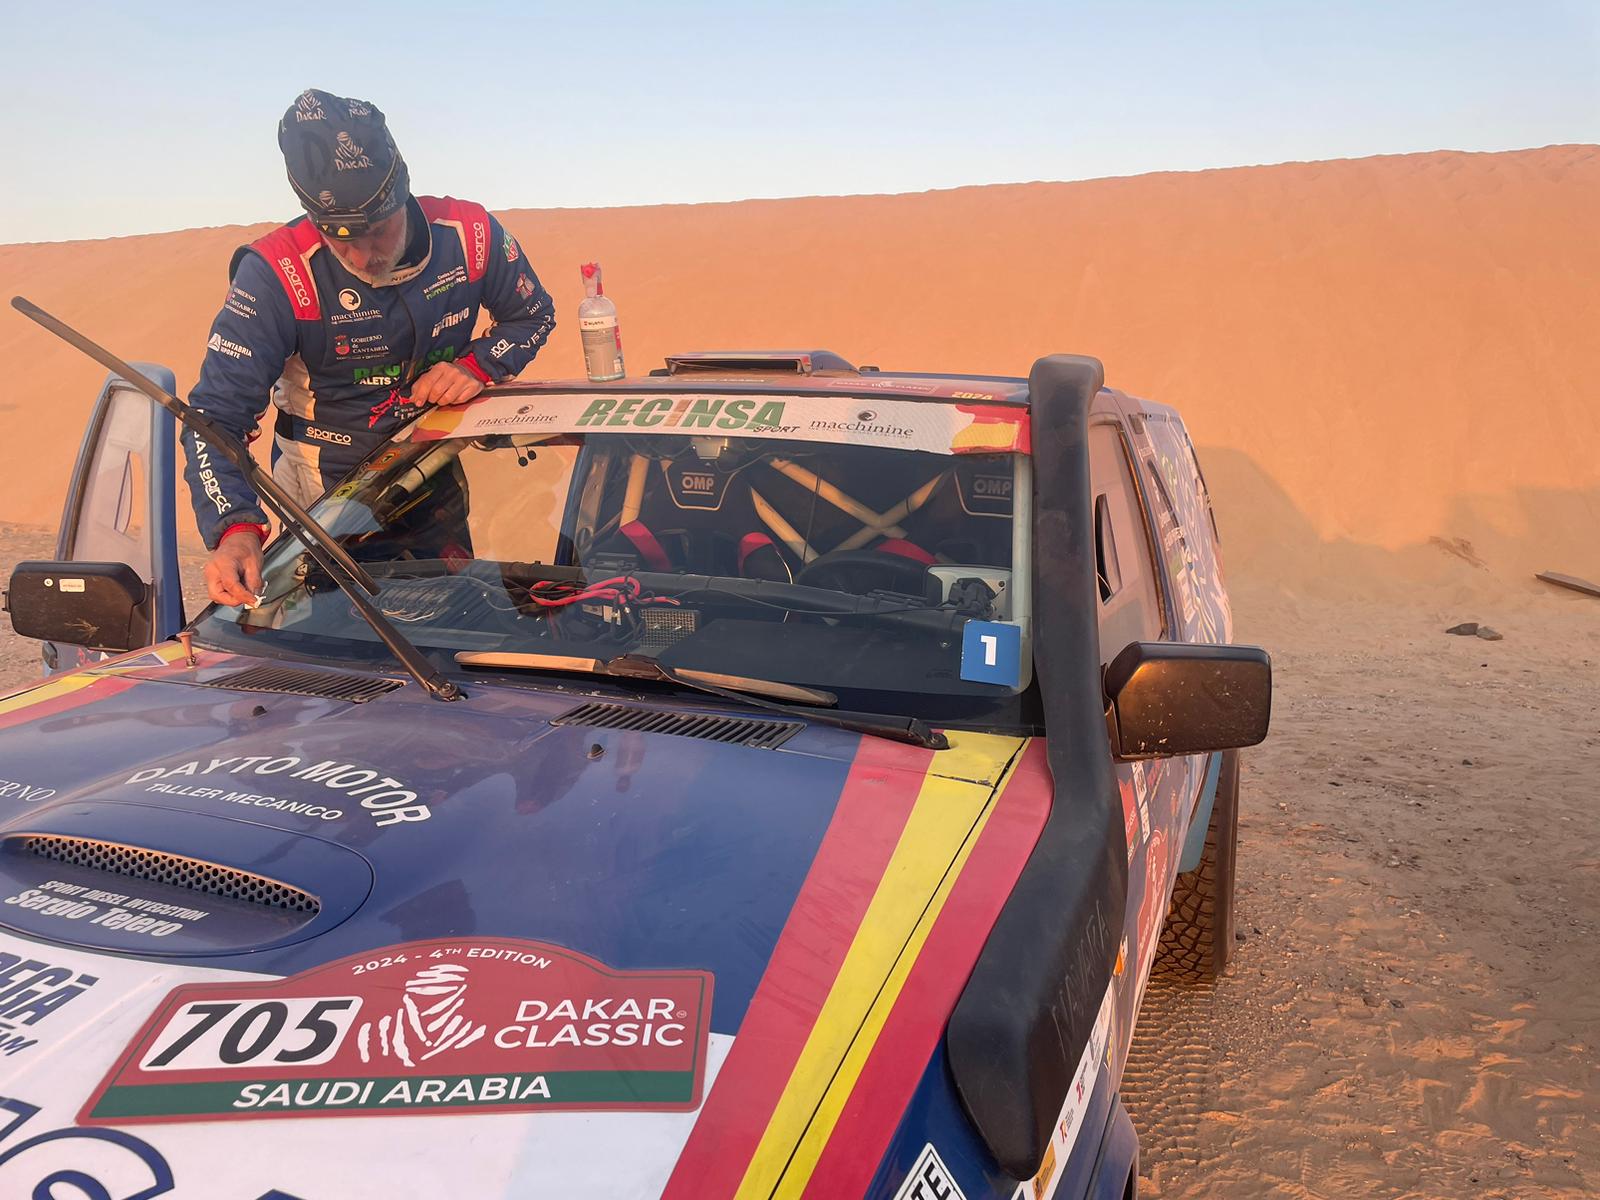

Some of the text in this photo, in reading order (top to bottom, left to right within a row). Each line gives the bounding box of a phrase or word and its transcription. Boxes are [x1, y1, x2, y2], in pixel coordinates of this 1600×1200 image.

[296, 107, 327, 122] DAKAR
[335, 155, 374, 171] DAKAR
[473, 222, 484, 270] sparco
[281, 257, 311, 307] sparco
[331, 309, 381, 321] macchinine
[354, 376, 391, 386] ALETS
[477, 414, 558, 426] macchinine
[575, 399, 785, 429] RECINSA
[306, 426, 352, 444] sparco
[752, 425, 801, 433] SPORT
[809, 420, 914, 436] macchinine
[682, 475, 715, 491] OMP
[974, 479, 1012, 495] OMP
[980, 635, 997, 666] 1
[125, 756, 431, 827] DAYTO MOTOR
[145, 783, 343, 820] TALLER MECANICO
[38, 881, 90, 896] SPORT
[80, 889, 130, 905] DIESEL
[5, 889, 183, 937] Sergio Tejero
[352, 954, 408, 975] 2024
[429, 947, 462, 959] 4TH
[466, 947, 552, 970] EDITION
[515, 998, 675, 1022] DAKAR
[145, 999, 350, 1068] 705
[494, 1023, 685, 1049] CLASSIC
[232, 1075, 552, 1109] SAUDI ARABIA
